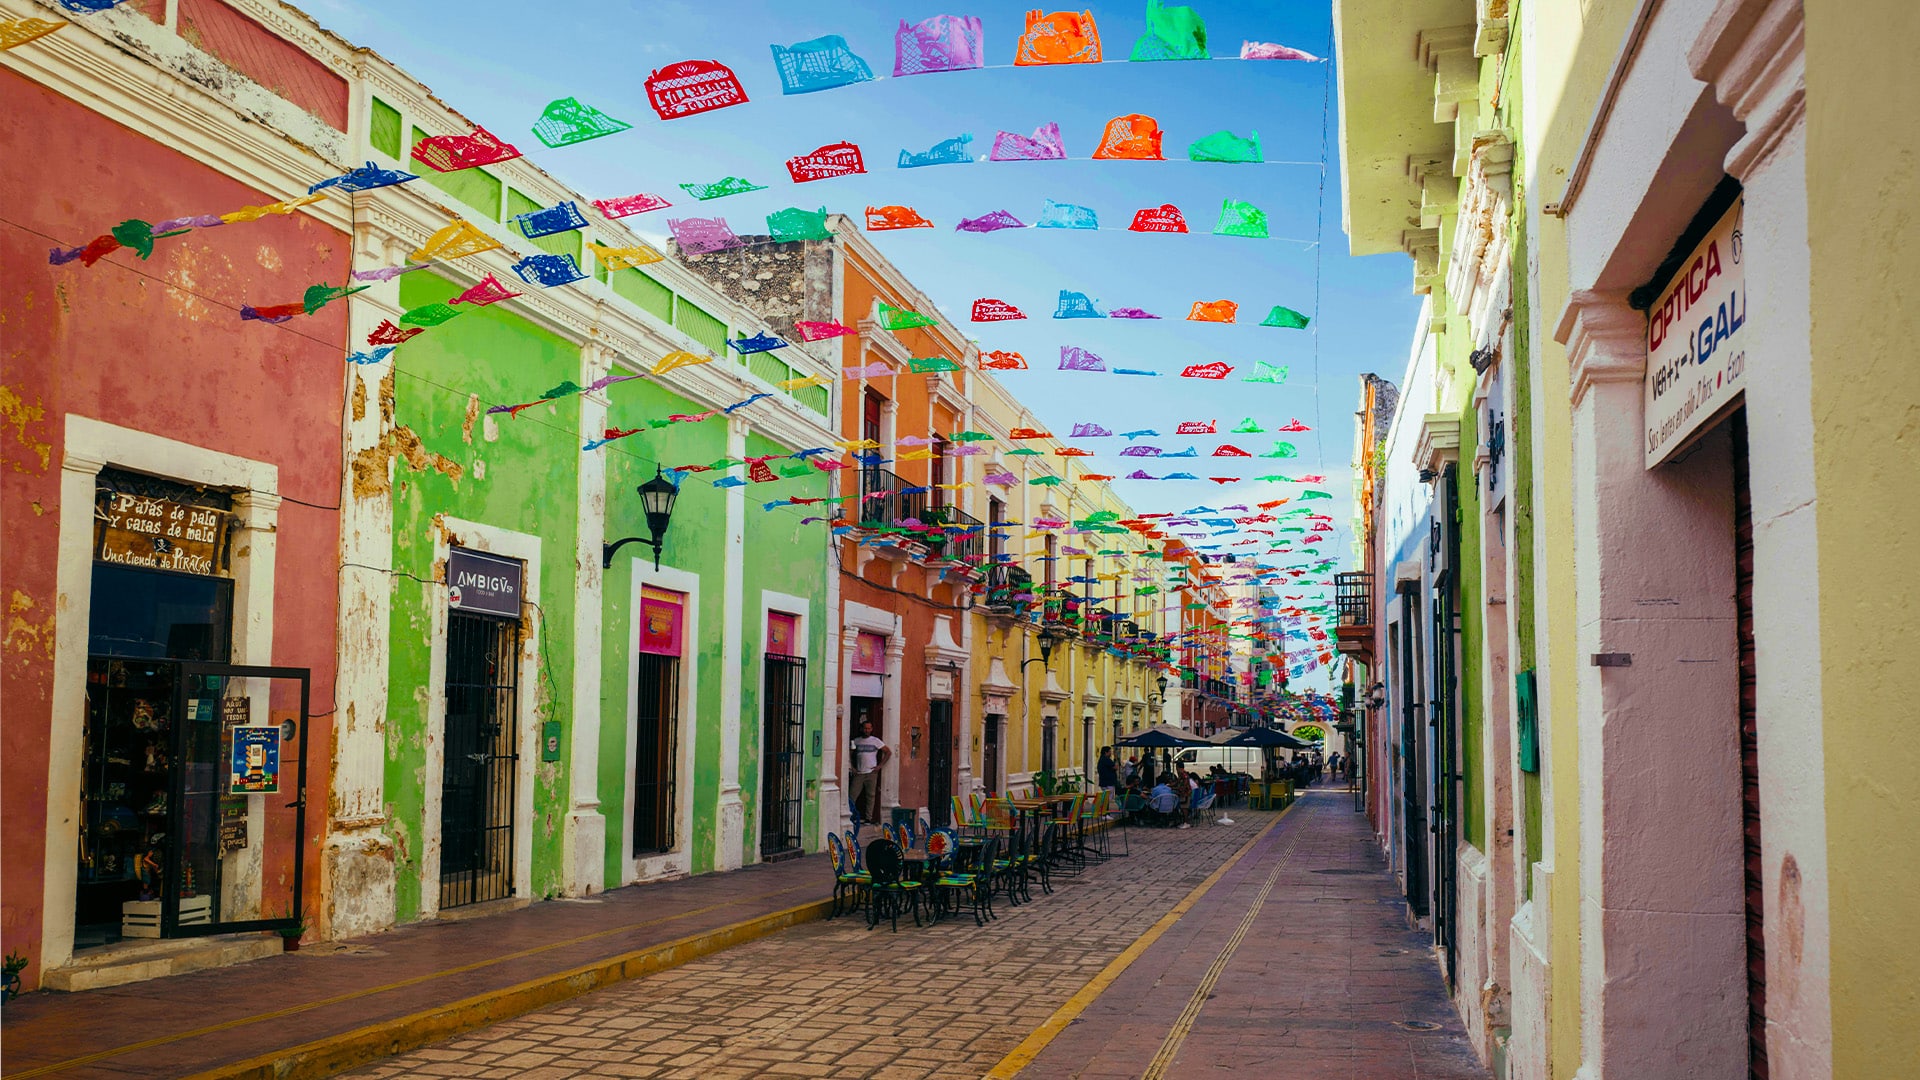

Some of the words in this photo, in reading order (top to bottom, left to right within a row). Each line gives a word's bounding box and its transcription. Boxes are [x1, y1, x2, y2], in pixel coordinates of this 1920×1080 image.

[1650, 240, 1721, 352] OPTICA
[1648, 428, 1659, 454] Sus
[1660, 415, 1675, 446] lentes
[1676, 407, 1683, 429] en
[1695, 380, 1702, 409] 2
[117, 496, 163, 517] Patas
[170, 505, 185, 521] de
[189, 510, 217, 527] palo
[126, 517, 162, 534] caras
[167, 521, 182, 538] de
[186, 526, 214, 543] malo
[102, 543, 125, 563] Una
[126, 550, 157, 568] tienda
[161, 555, 171, 569] de
